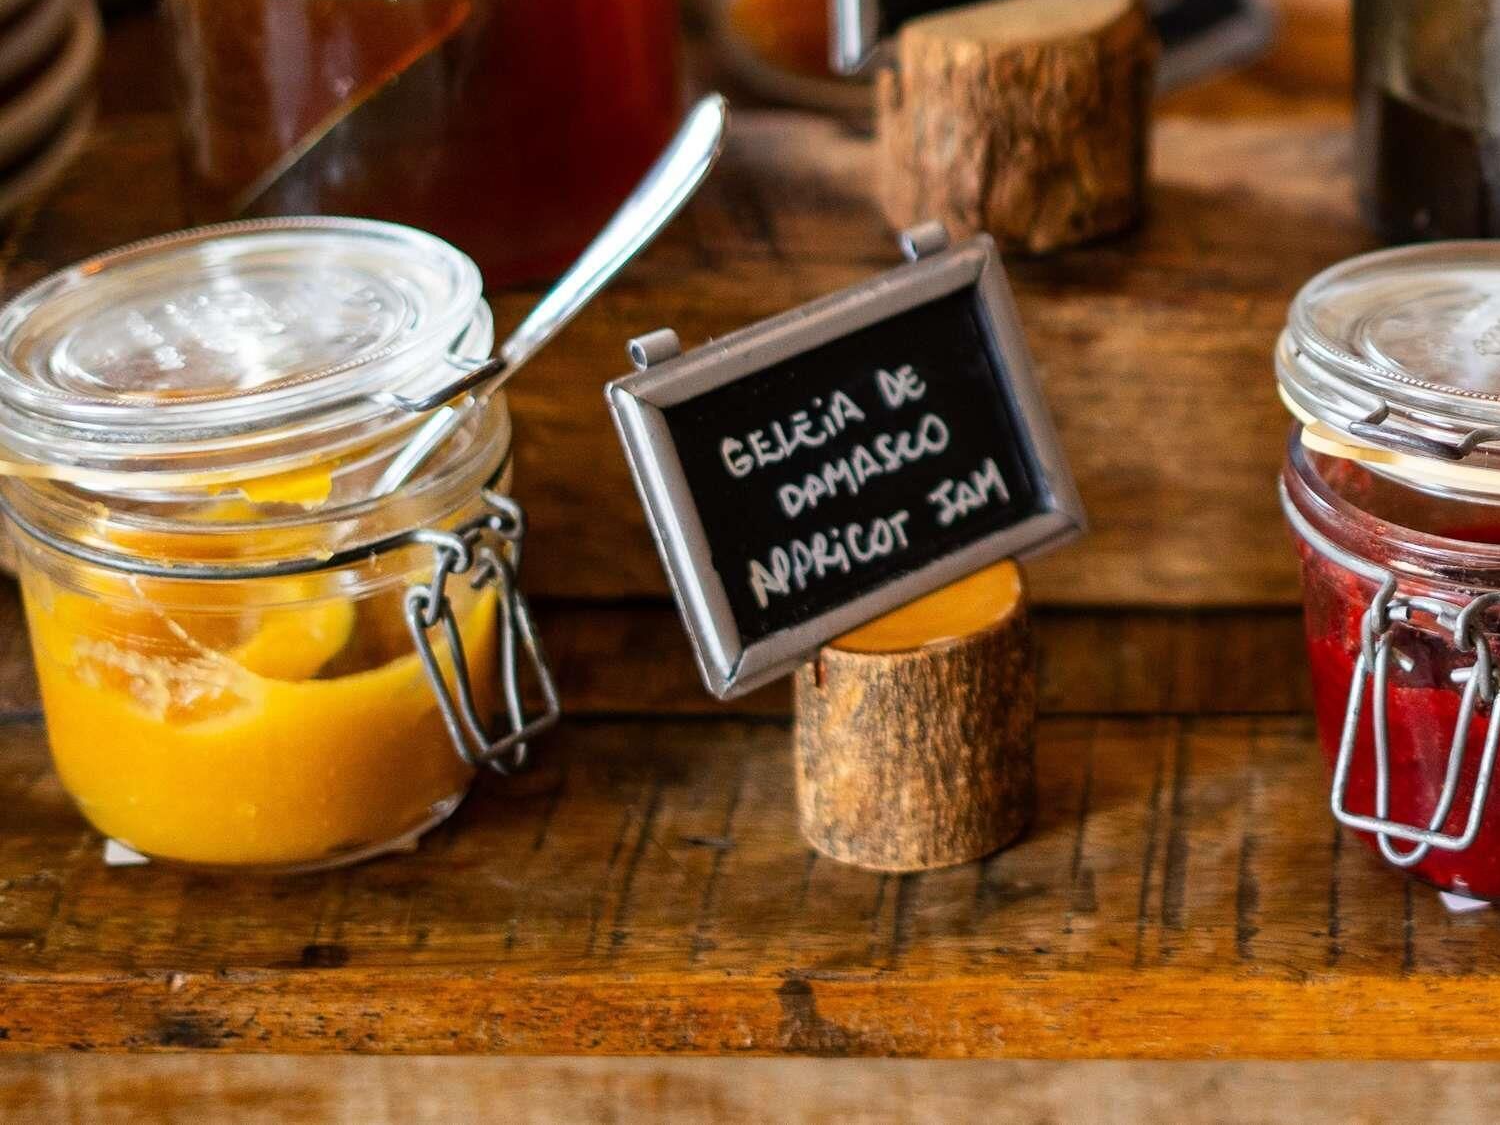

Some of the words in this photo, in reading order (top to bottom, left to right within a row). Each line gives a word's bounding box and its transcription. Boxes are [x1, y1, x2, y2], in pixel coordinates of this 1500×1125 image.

[876, 364, 926, 408] DE
[778, 414, 949, 517] DAMASCO
[928, 458, 1010, 524] JAM
